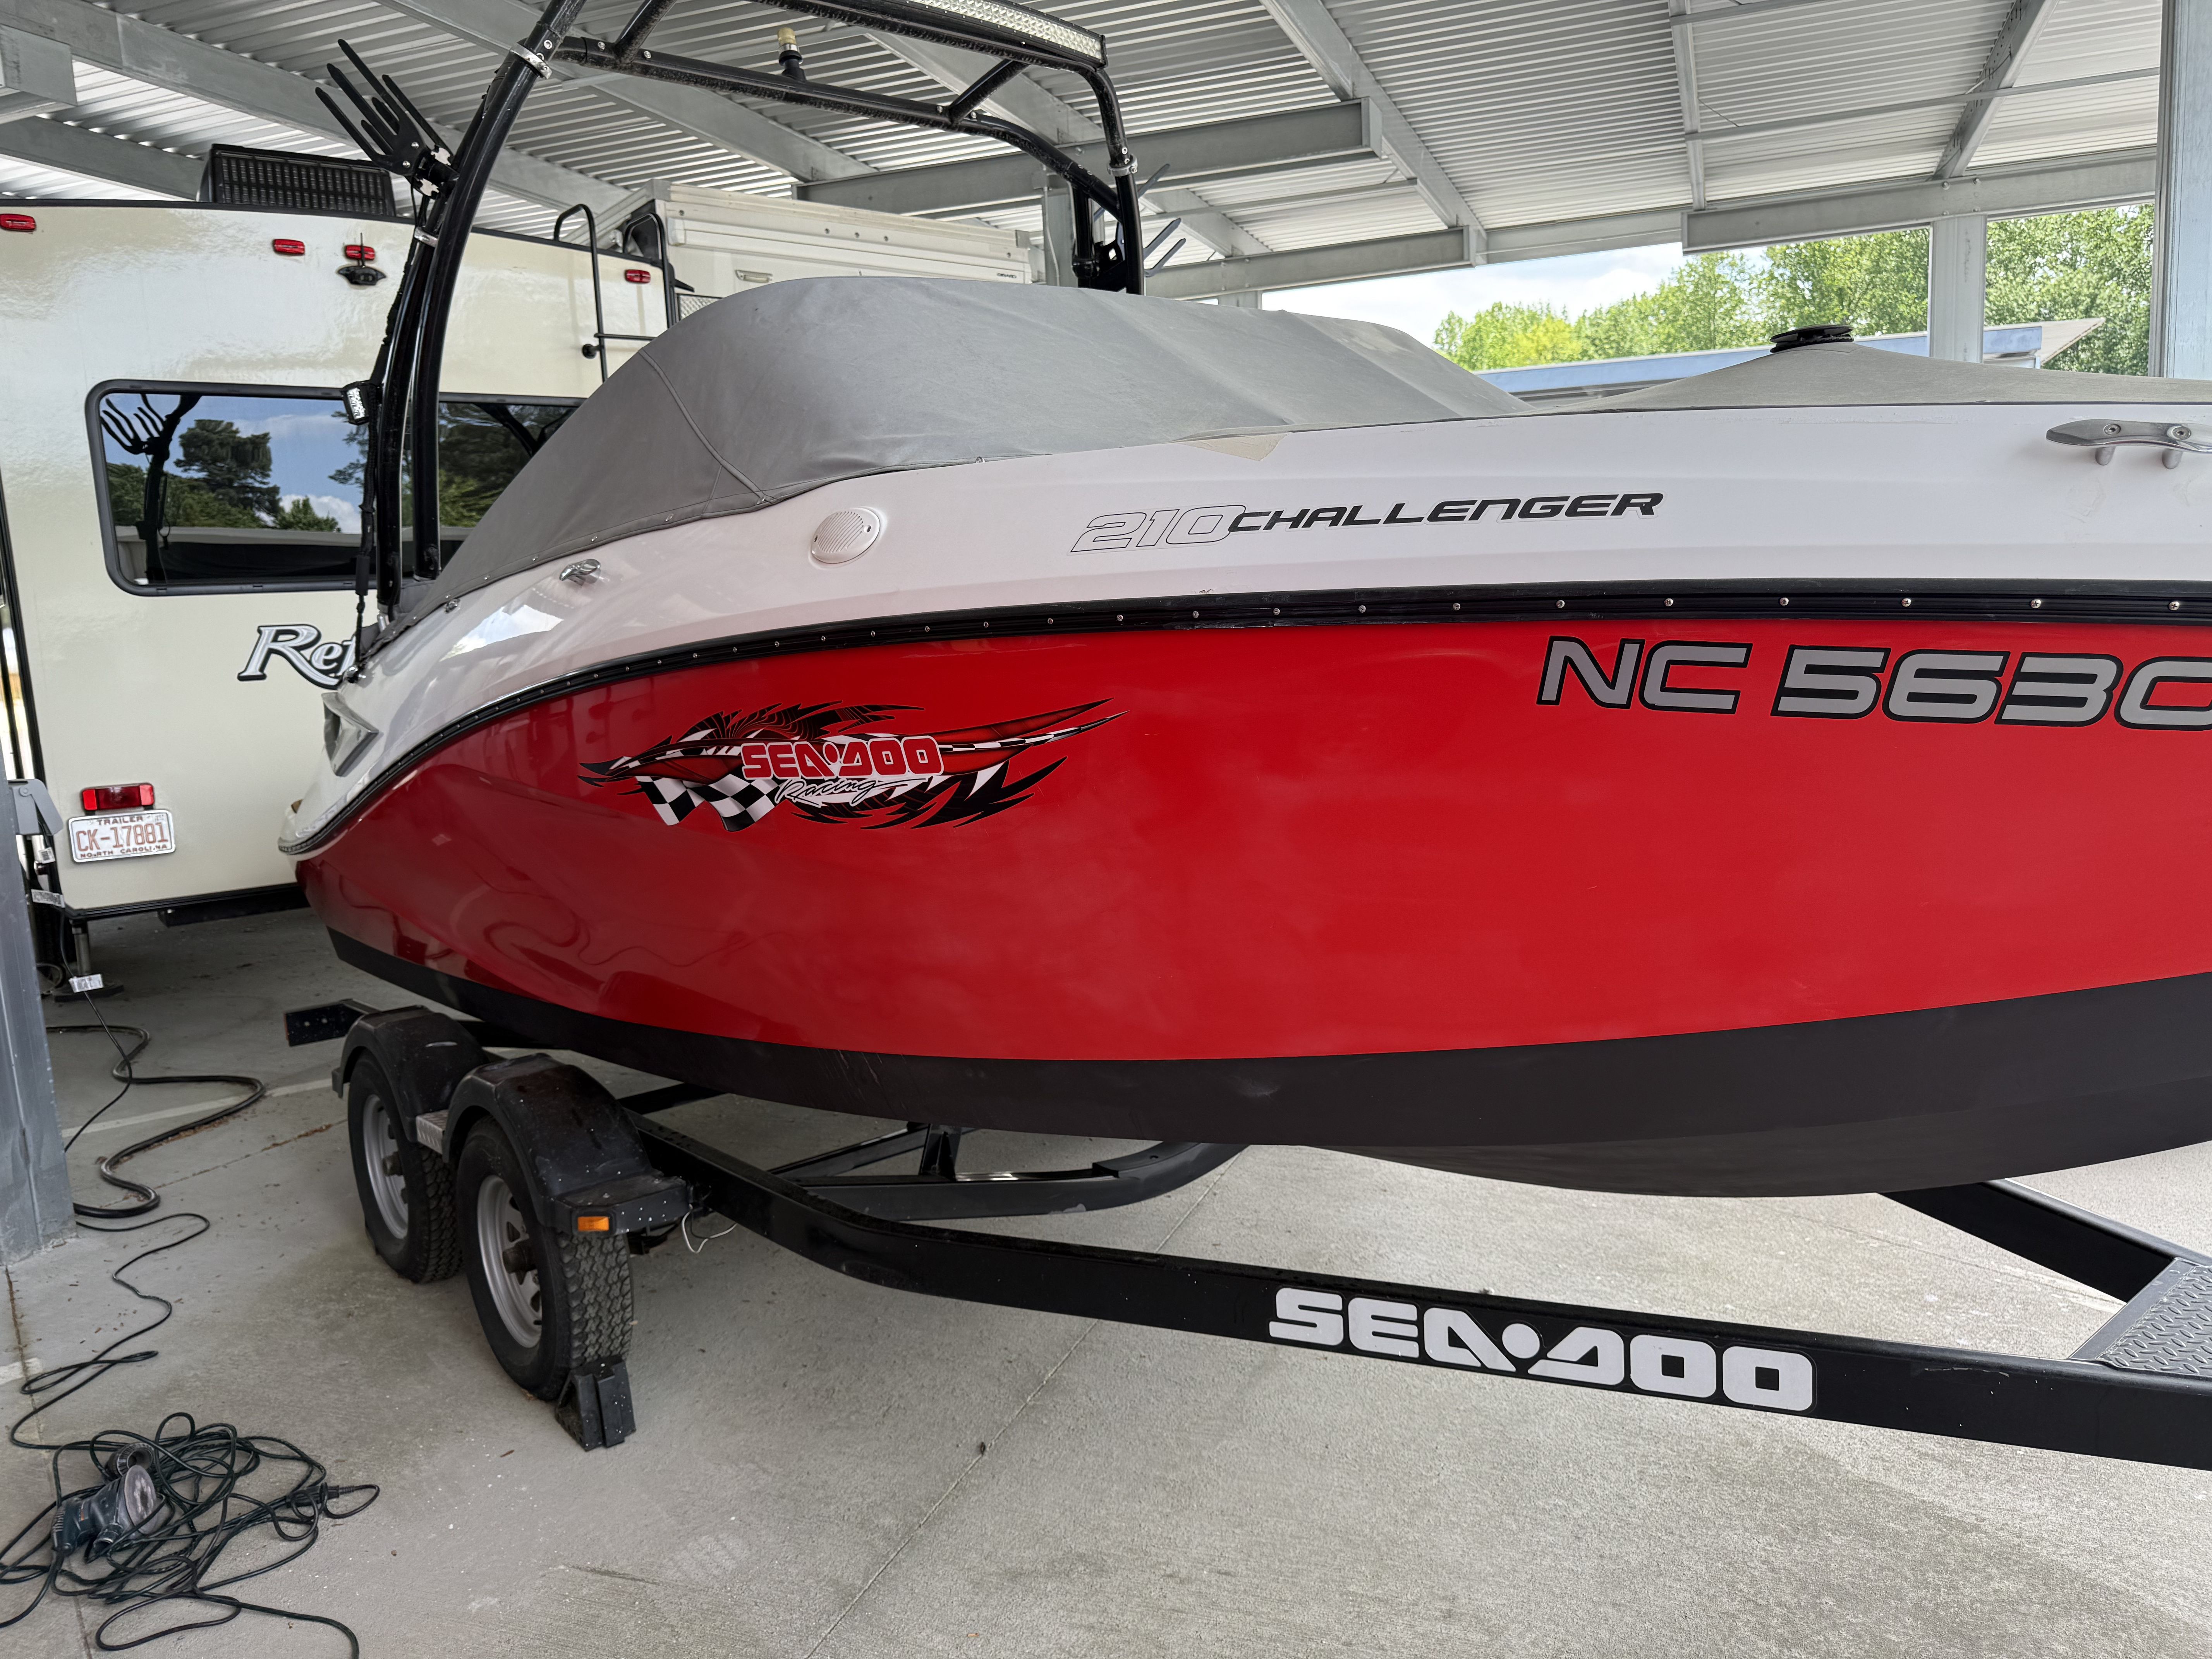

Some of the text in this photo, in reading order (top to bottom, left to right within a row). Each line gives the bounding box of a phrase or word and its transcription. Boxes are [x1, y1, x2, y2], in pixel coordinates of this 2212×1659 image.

[1229, 493, 1664, 532] CHALLENGER
[1536, 635, 1753, 714] NC
[775, 778, 929, 808] Racing
[97, 816, 143, 826] TRAILER
[76, 822, 168, 852] CK-17881
[120, 844, 167, 854] CAROLINA
